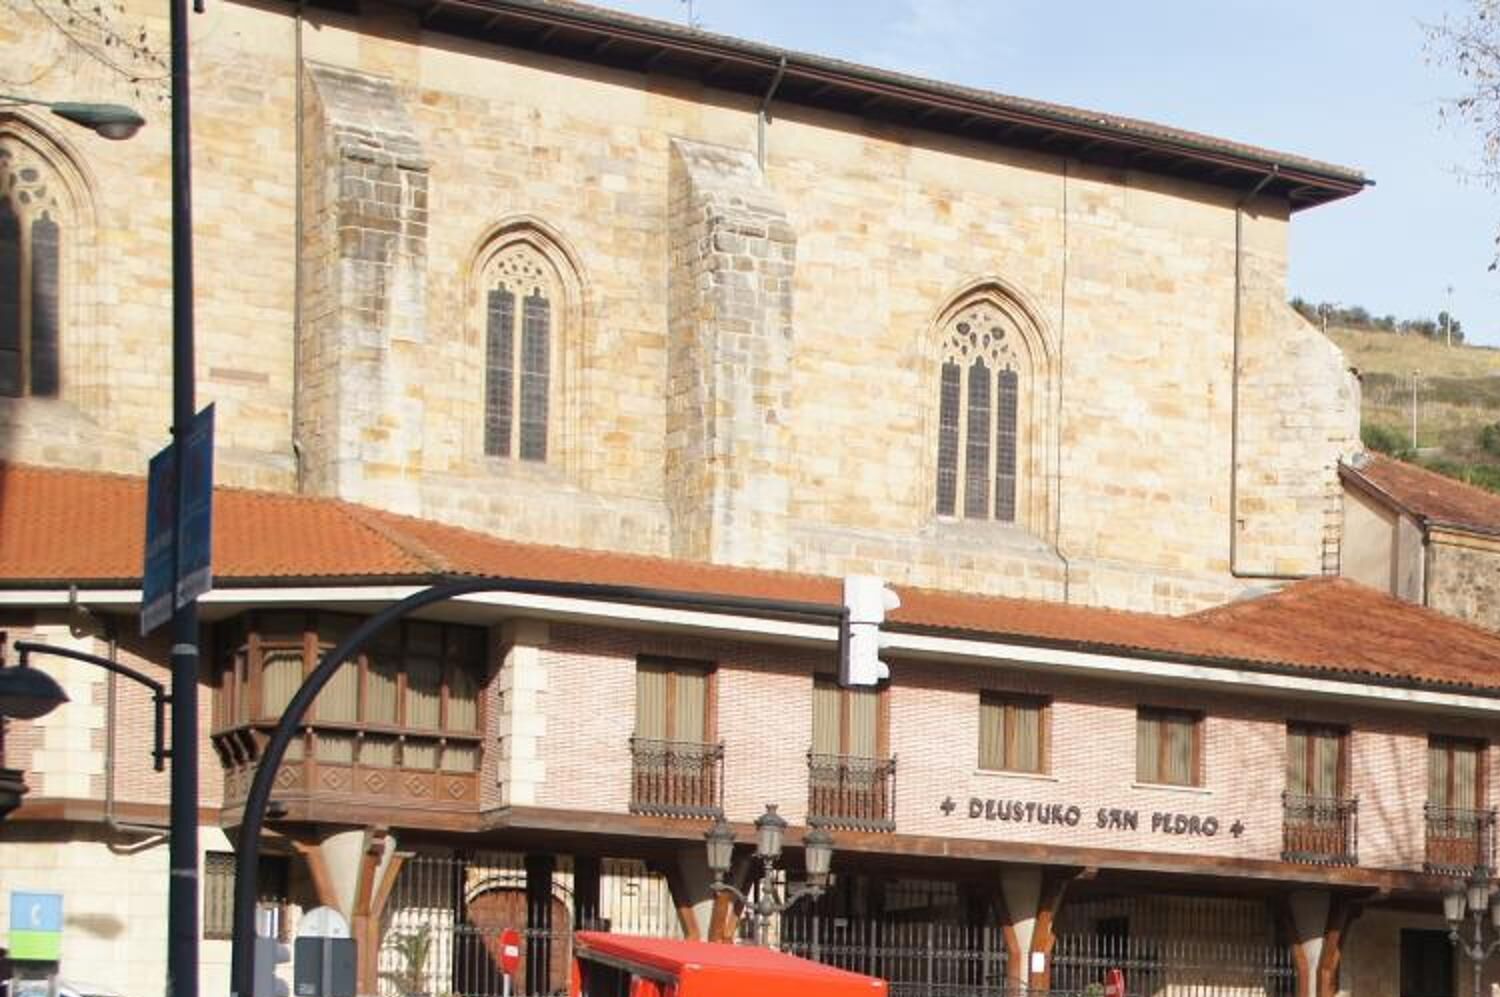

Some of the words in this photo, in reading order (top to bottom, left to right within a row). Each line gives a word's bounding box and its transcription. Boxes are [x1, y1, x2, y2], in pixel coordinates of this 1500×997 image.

[969, 797, 1081, 827] DEUSTUKO
[1096, 807, 1139, 831] SAN
[1152, 812, 1219, 837] PEDRO
